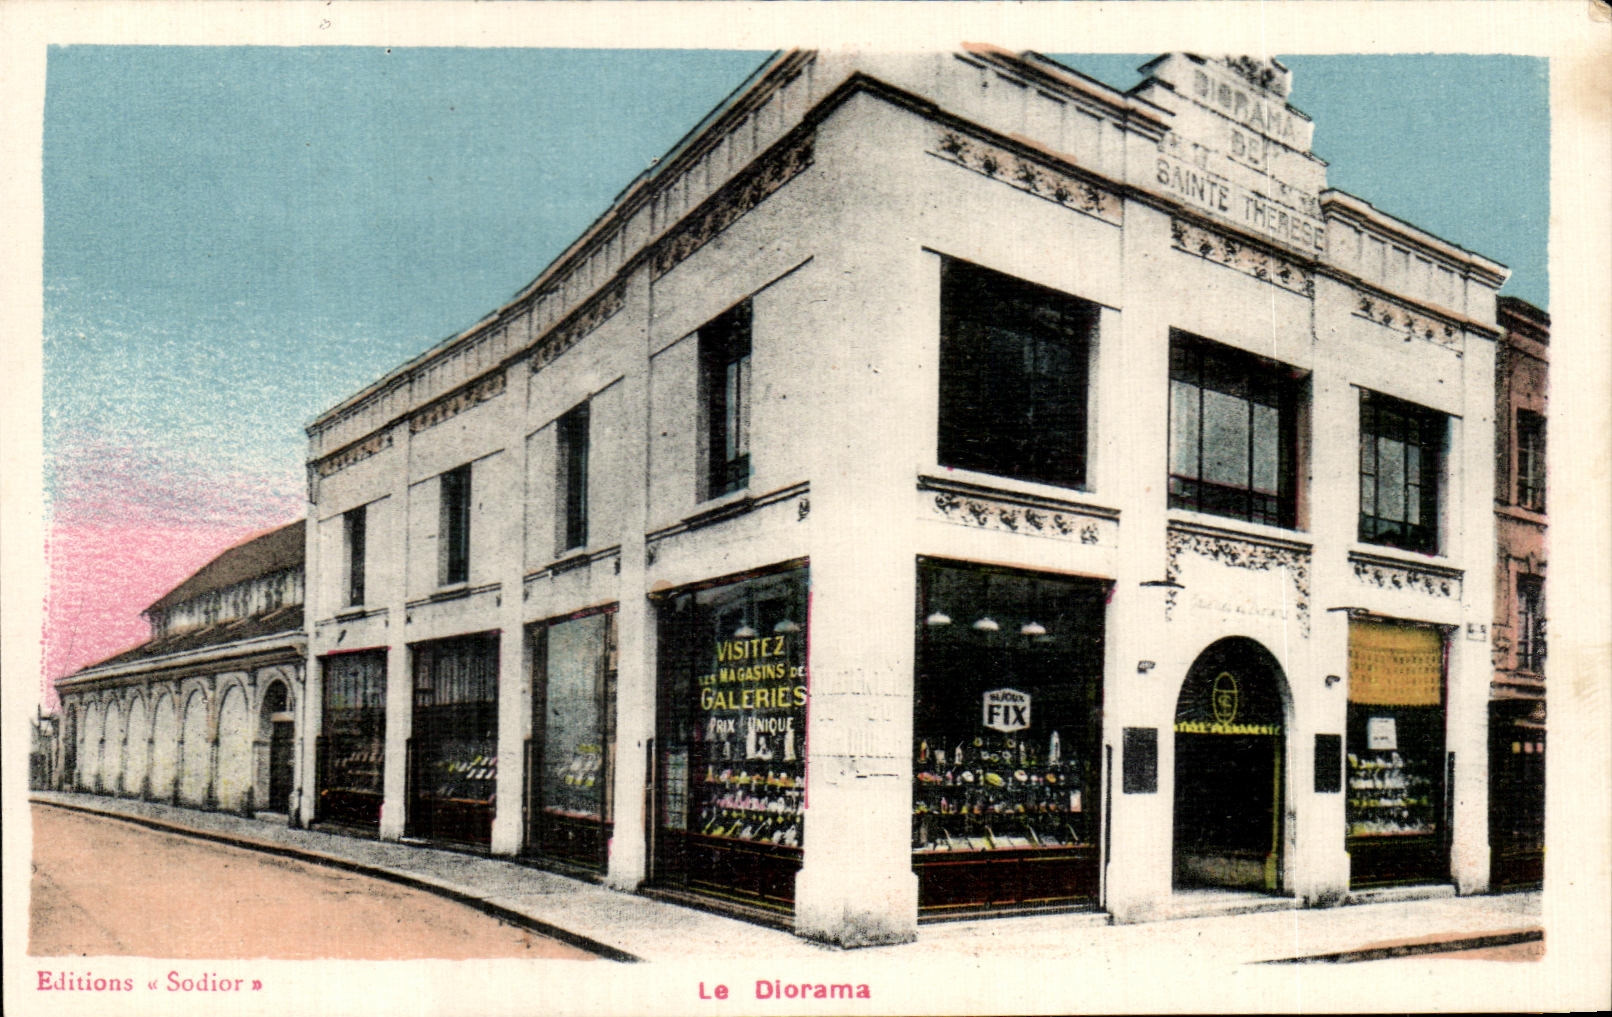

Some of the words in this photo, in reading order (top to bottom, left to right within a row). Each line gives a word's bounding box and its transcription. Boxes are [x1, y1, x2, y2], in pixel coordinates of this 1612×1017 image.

[1194, 69, 1296, 142] DIORAMA
[1156, 158, 1230, 212] SAINTE
[1241, 194, 1326, 252] THERESE
[717, 636, 785, 662] VISITEZ
[719, 663, 785, 683] MAGASINS
[701, 685, 808, 711] GALERIES
[710, 716, 735, 734] PRIX
[747, 716, 794, 737] UNIQUE
[988, 704, 1026, 727] FIX
